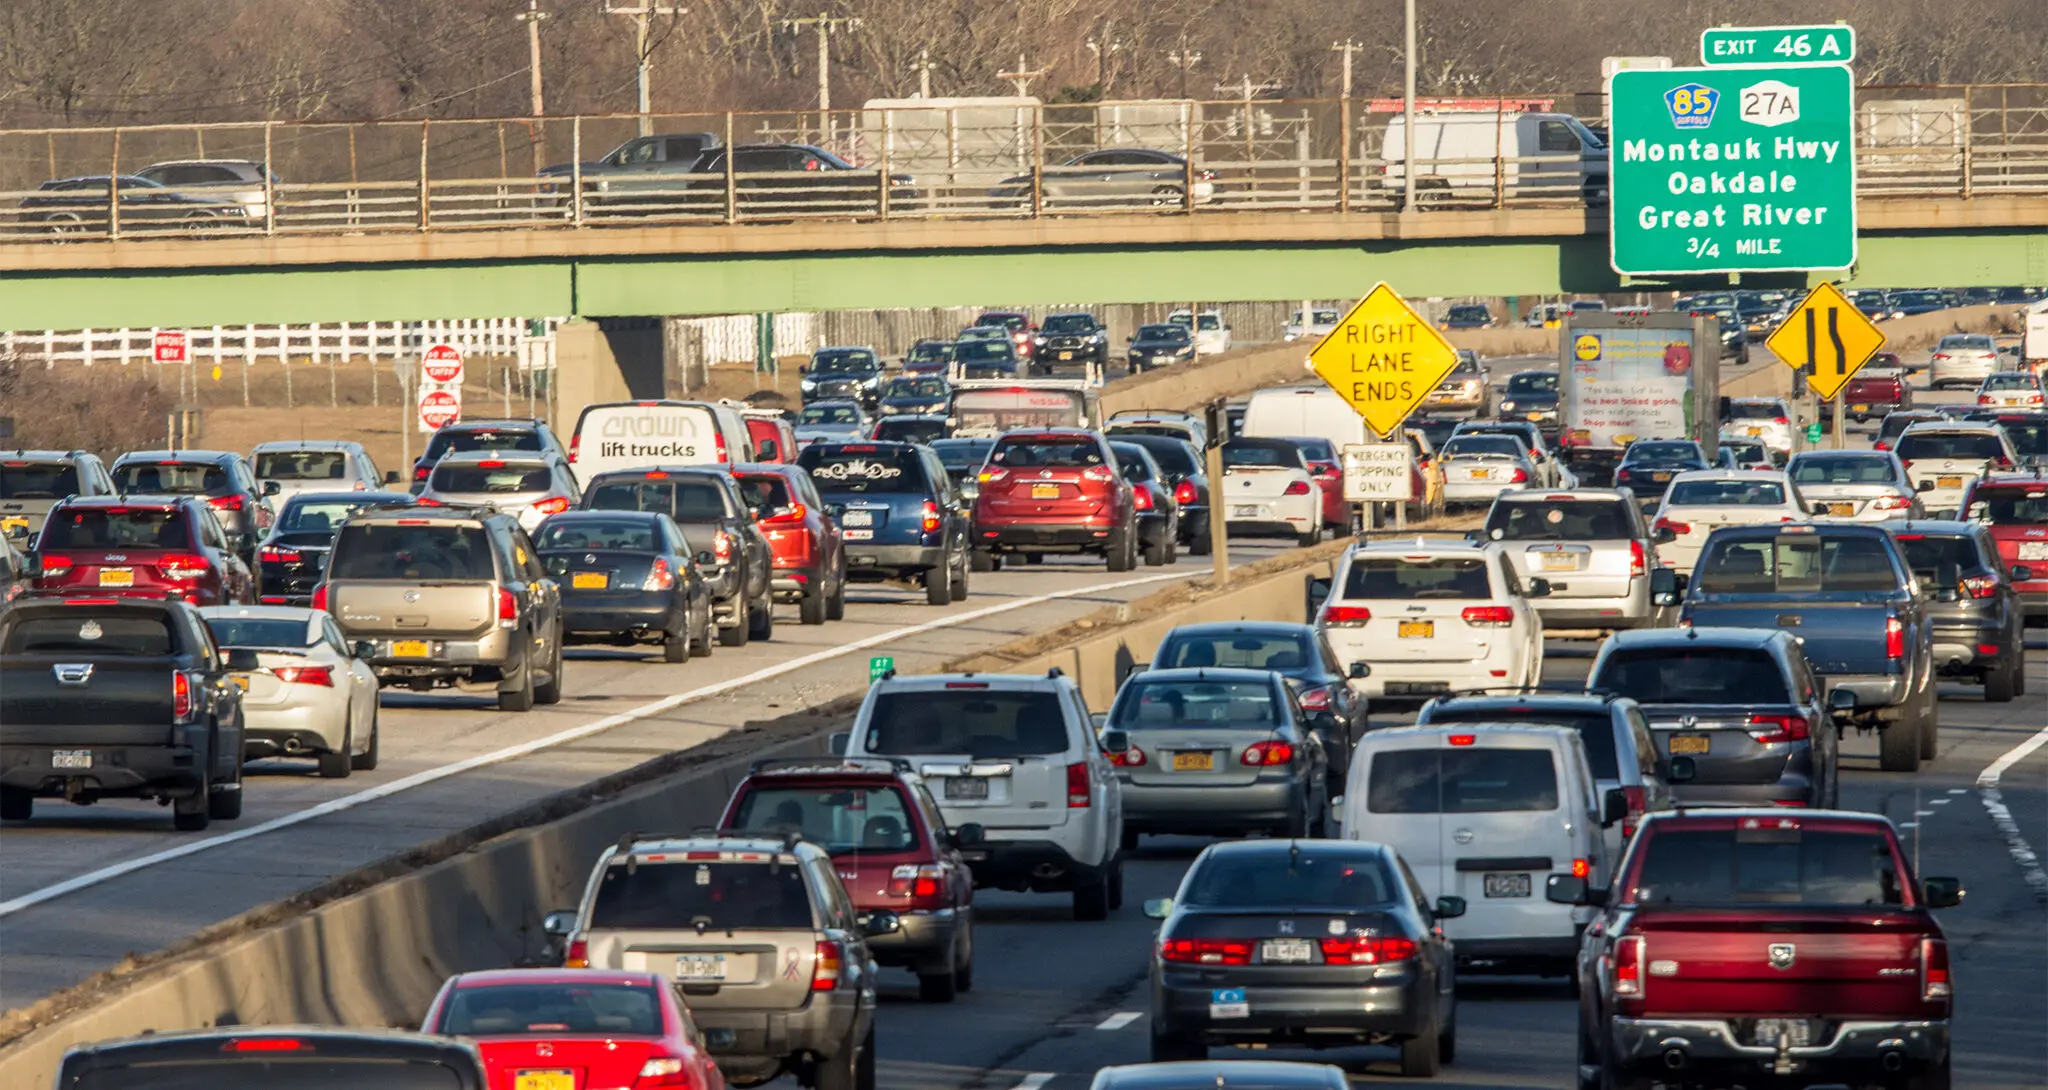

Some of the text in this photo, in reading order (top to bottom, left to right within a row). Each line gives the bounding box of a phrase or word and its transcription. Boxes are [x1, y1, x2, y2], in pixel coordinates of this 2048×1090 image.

[1713, 34, 1841, 57] EXIT 46 A
[1672, 88, 1712, 115] 85
[1744, 92, 1795, 115] 27A
[1623, 136, 1840, 164] Montauk Hwy
[1668, 170, 1797, 195] Oakdale
[1639, 203, 1828, 230] Great River
[1686, 237, 1782, 259] 3/4 MILE
[1346, 323, 1417, 344] RIGHT
[1351, 352, 1414, 373] LANE
[1029, 398, 1071, 406] NISSAN
[1353, 381, 1413, 402] ENDS
[601, 416, 698, 439] CROWN
[601, 442, 696, 457] lift trucks
[1346, 450, 1405, 461] MERGENCY
[1359, 481, 1392, 492] ONLY
[104, 553, 127, 562] Jeep
